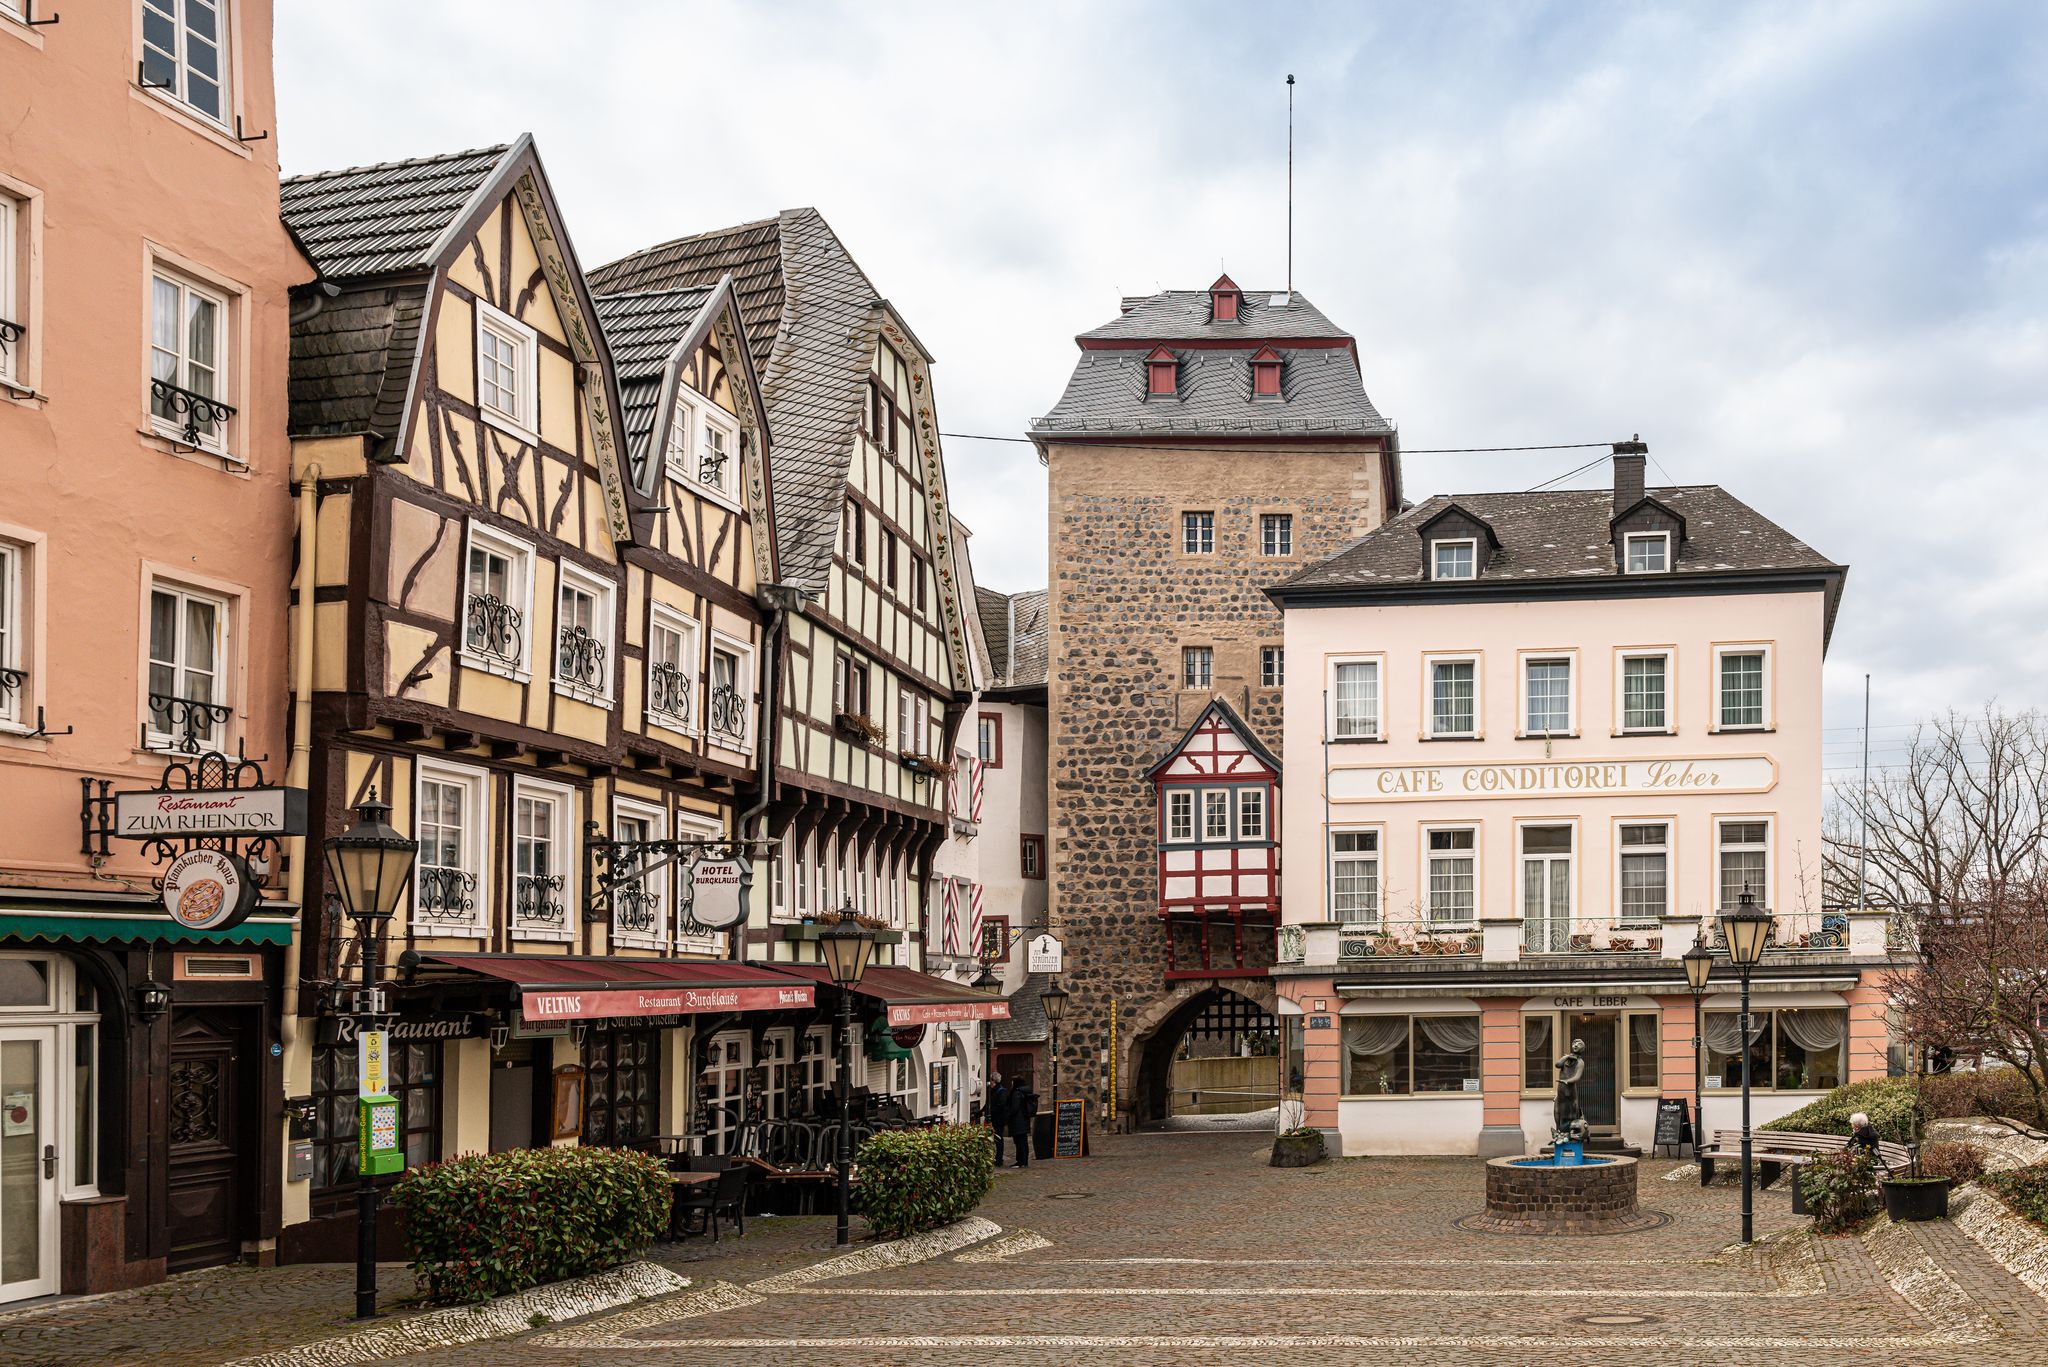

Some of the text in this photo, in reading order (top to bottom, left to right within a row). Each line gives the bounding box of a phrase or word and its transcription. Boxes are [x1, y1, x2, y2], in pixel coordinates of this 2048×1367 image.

[1376, 761, 1721, 794] CAFE CONDITOREI Leber
[158, 795, 245, 813] Restaurant
[127, 812, 278, 830] ZUM RHEINTOR
[165, 851, 238, 893] Pfannkuchen Haus
[701, 866, 734, 875] HOTEL
[695, 876, 739, 885] BURGKLAUSE
[537, 996, 581, 1014] VELTINS
[639, 996, 682, 1009] Restaurant
[685, 991, 739, 1010] Burgklause
[1553, 996, 1628, 1007] CAFE LEBER
